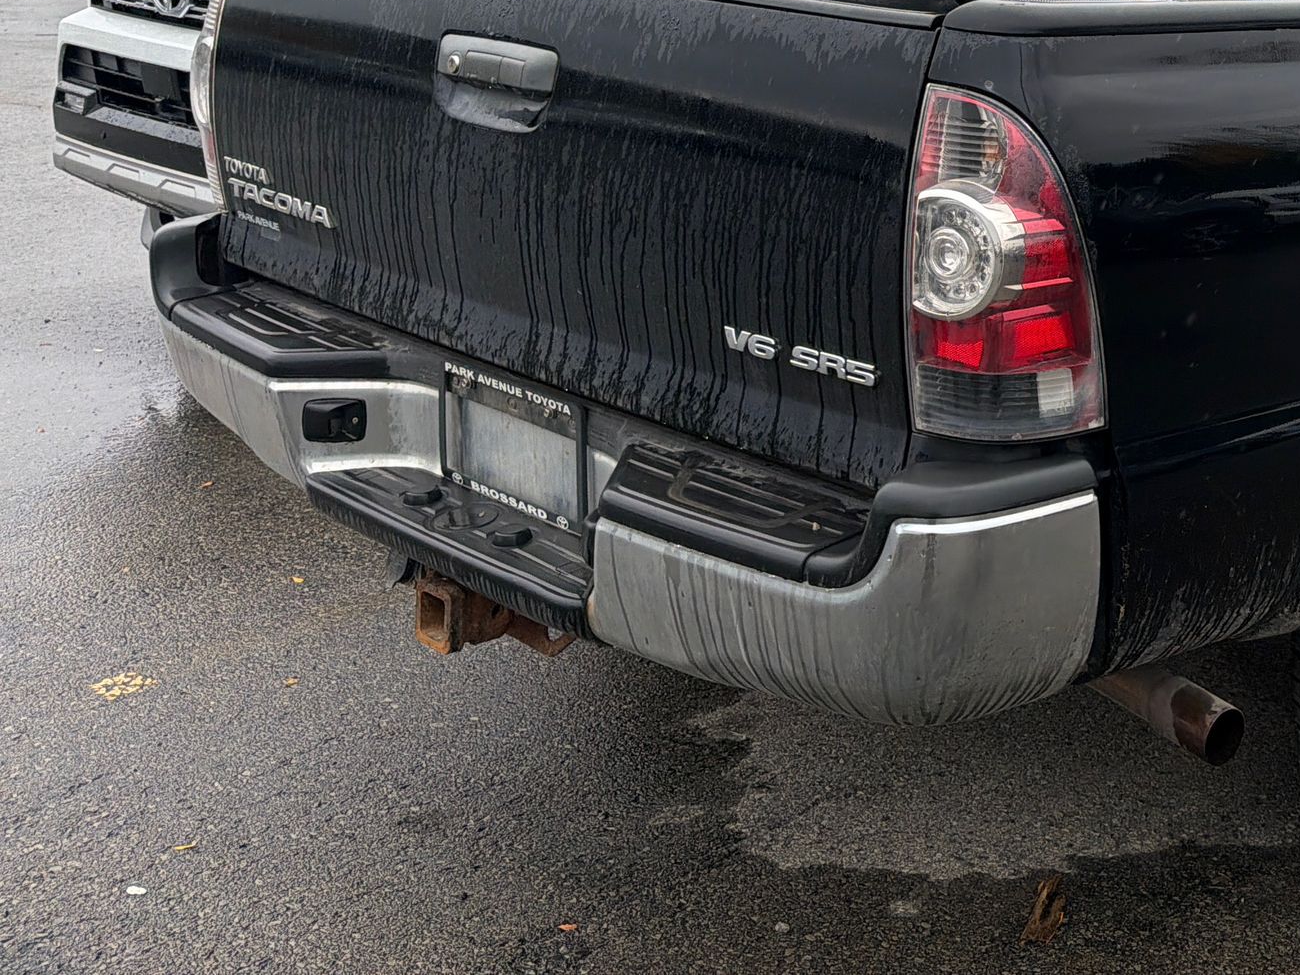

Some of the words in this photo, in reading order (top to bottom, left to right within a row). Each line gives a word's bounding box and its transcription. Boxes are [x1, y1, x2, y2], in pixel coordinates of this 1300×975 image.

[223, 155, 271, 186] TOYOTA
[227, 177, 333, 230] TACOMA
[723, 325, 777, 361] V6
[788, 344, 877, 387] SR5
[444, 361, 475, 381] PARK
[477, 374, 523, 399] AVENUE
[525, 390, 572, 416] TOYOTA
[470, 480, 548, 521] BROSSARD
